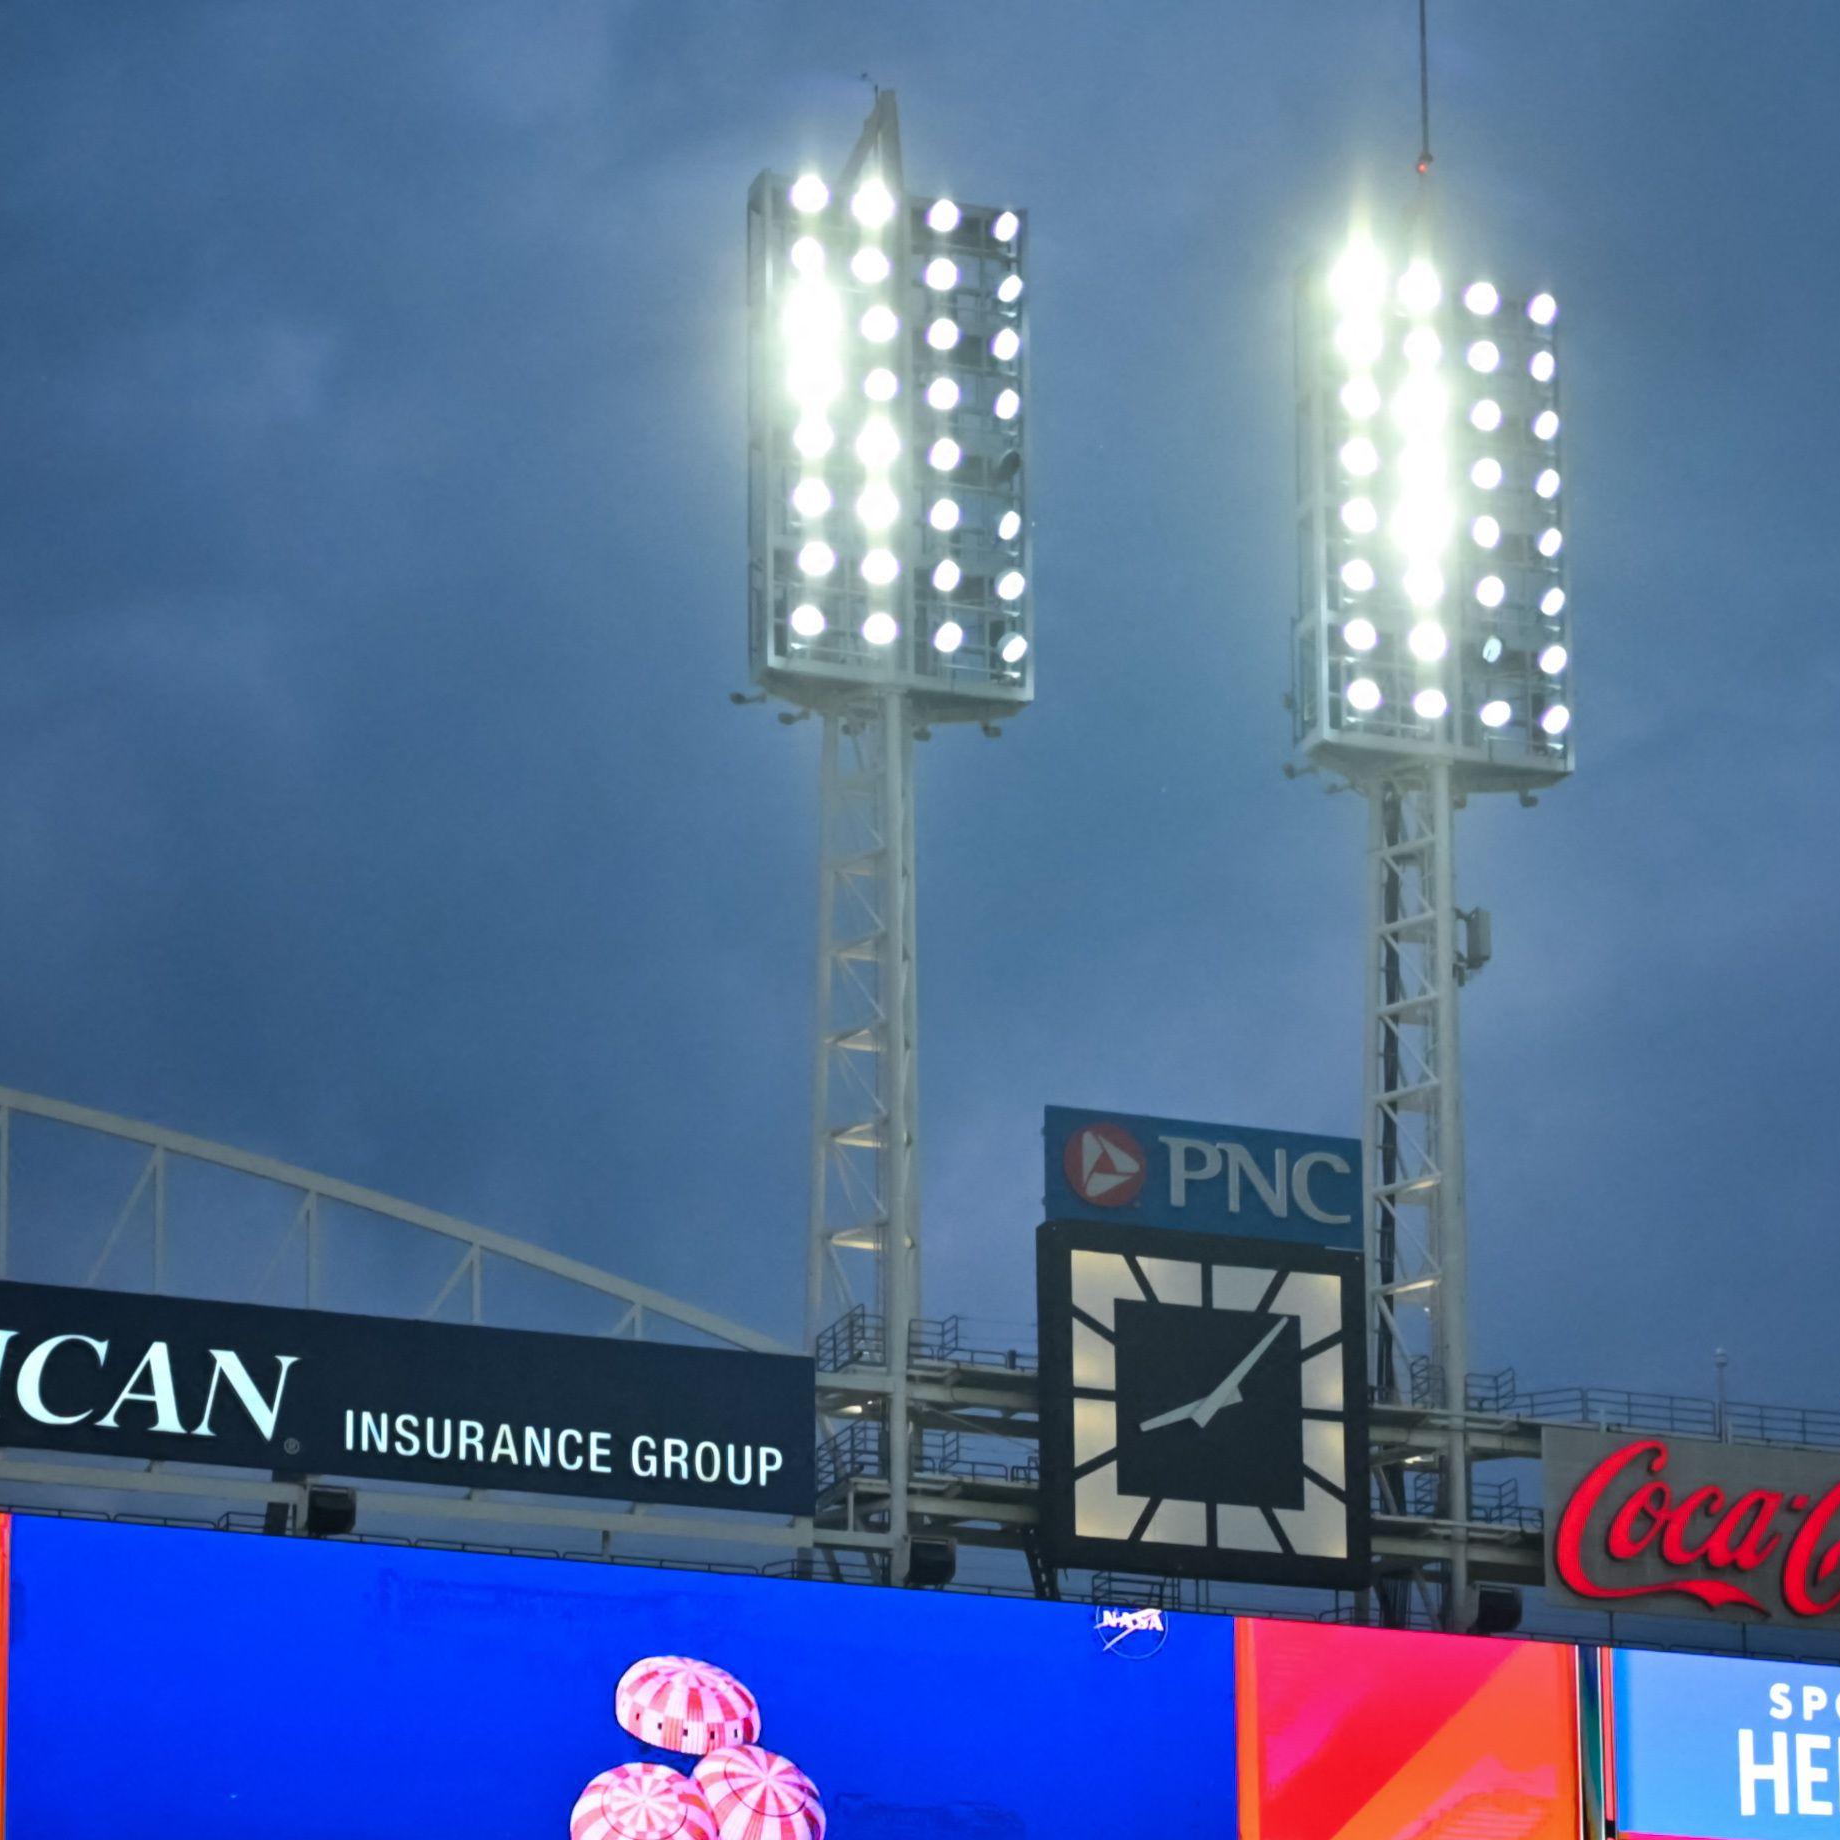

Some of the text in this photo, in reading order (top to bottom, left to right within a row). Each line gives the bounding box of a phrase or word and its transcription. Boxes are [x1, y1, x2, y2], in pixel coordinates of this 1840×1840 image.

[1158, 1135, 1352, 1224] PNC
[343, 1407, 612, 1474] INSURANCE
[631, 1434, 784, 1487] GROUP
